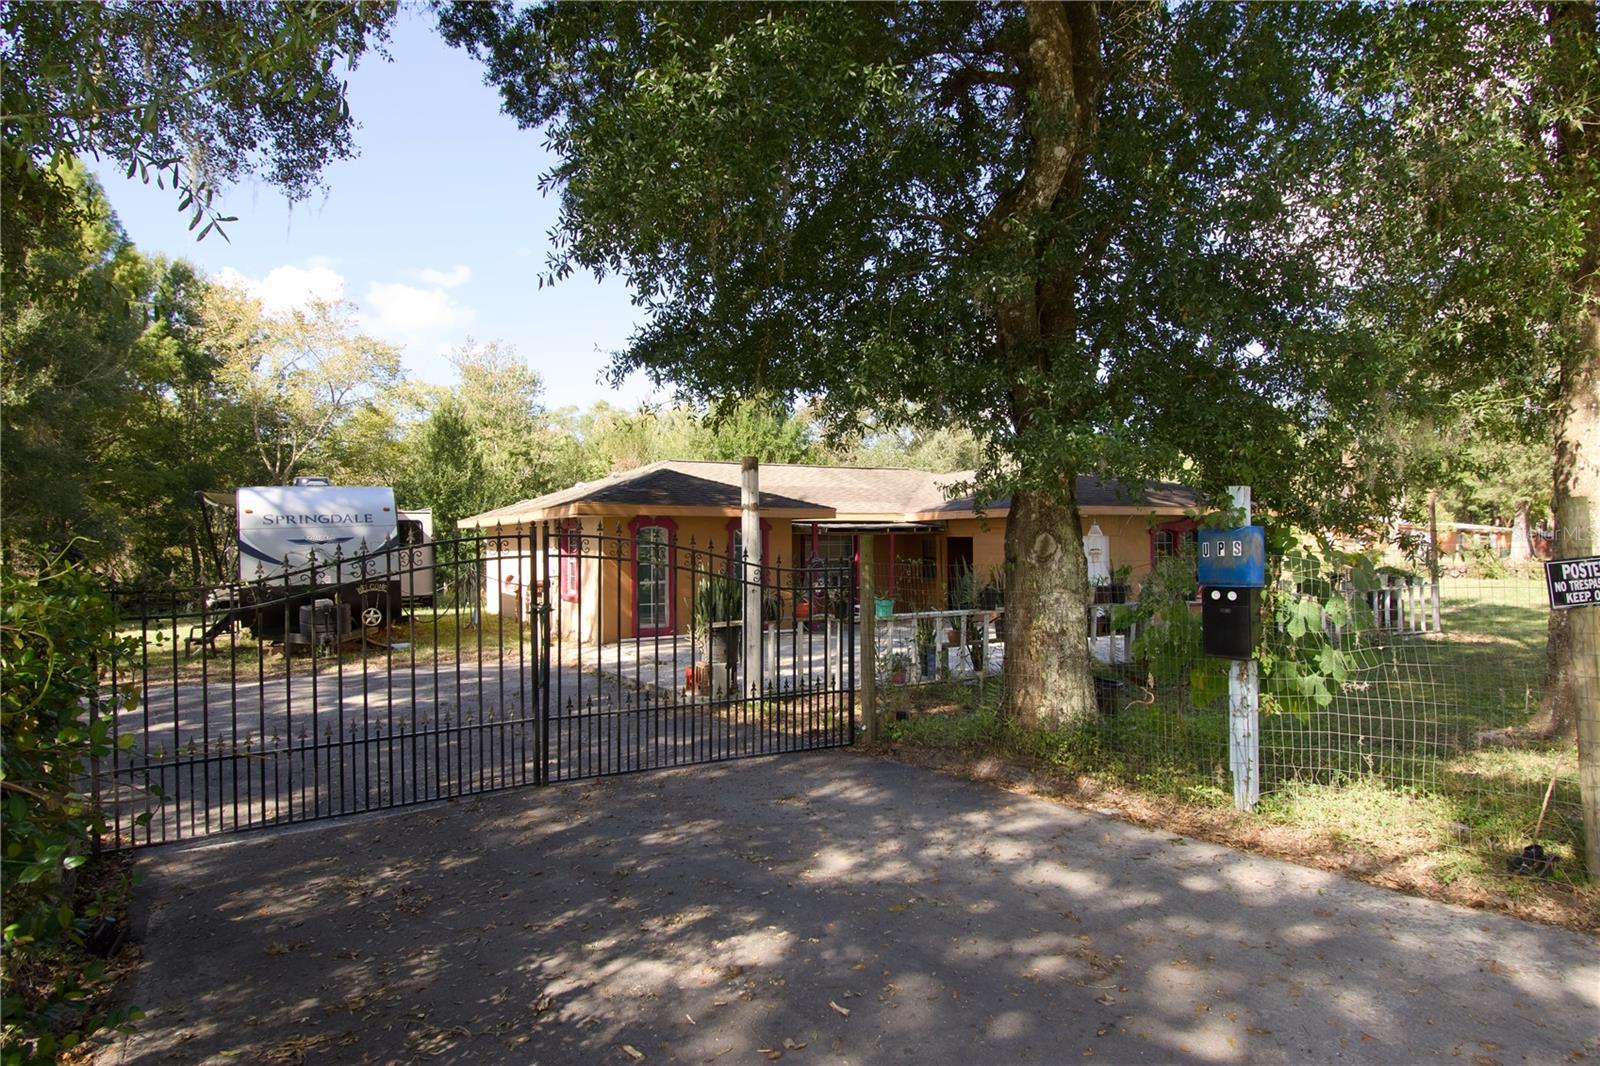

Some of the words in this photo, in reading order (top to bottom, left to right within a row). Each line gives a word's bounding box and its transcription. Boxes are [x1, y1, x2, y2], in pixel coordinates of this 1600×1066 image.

[262, 513, 374, 525] SPRINGDALE
[1561, 561, 1600, 580] POSTE
[1554, 581, 1567, 593] NO
